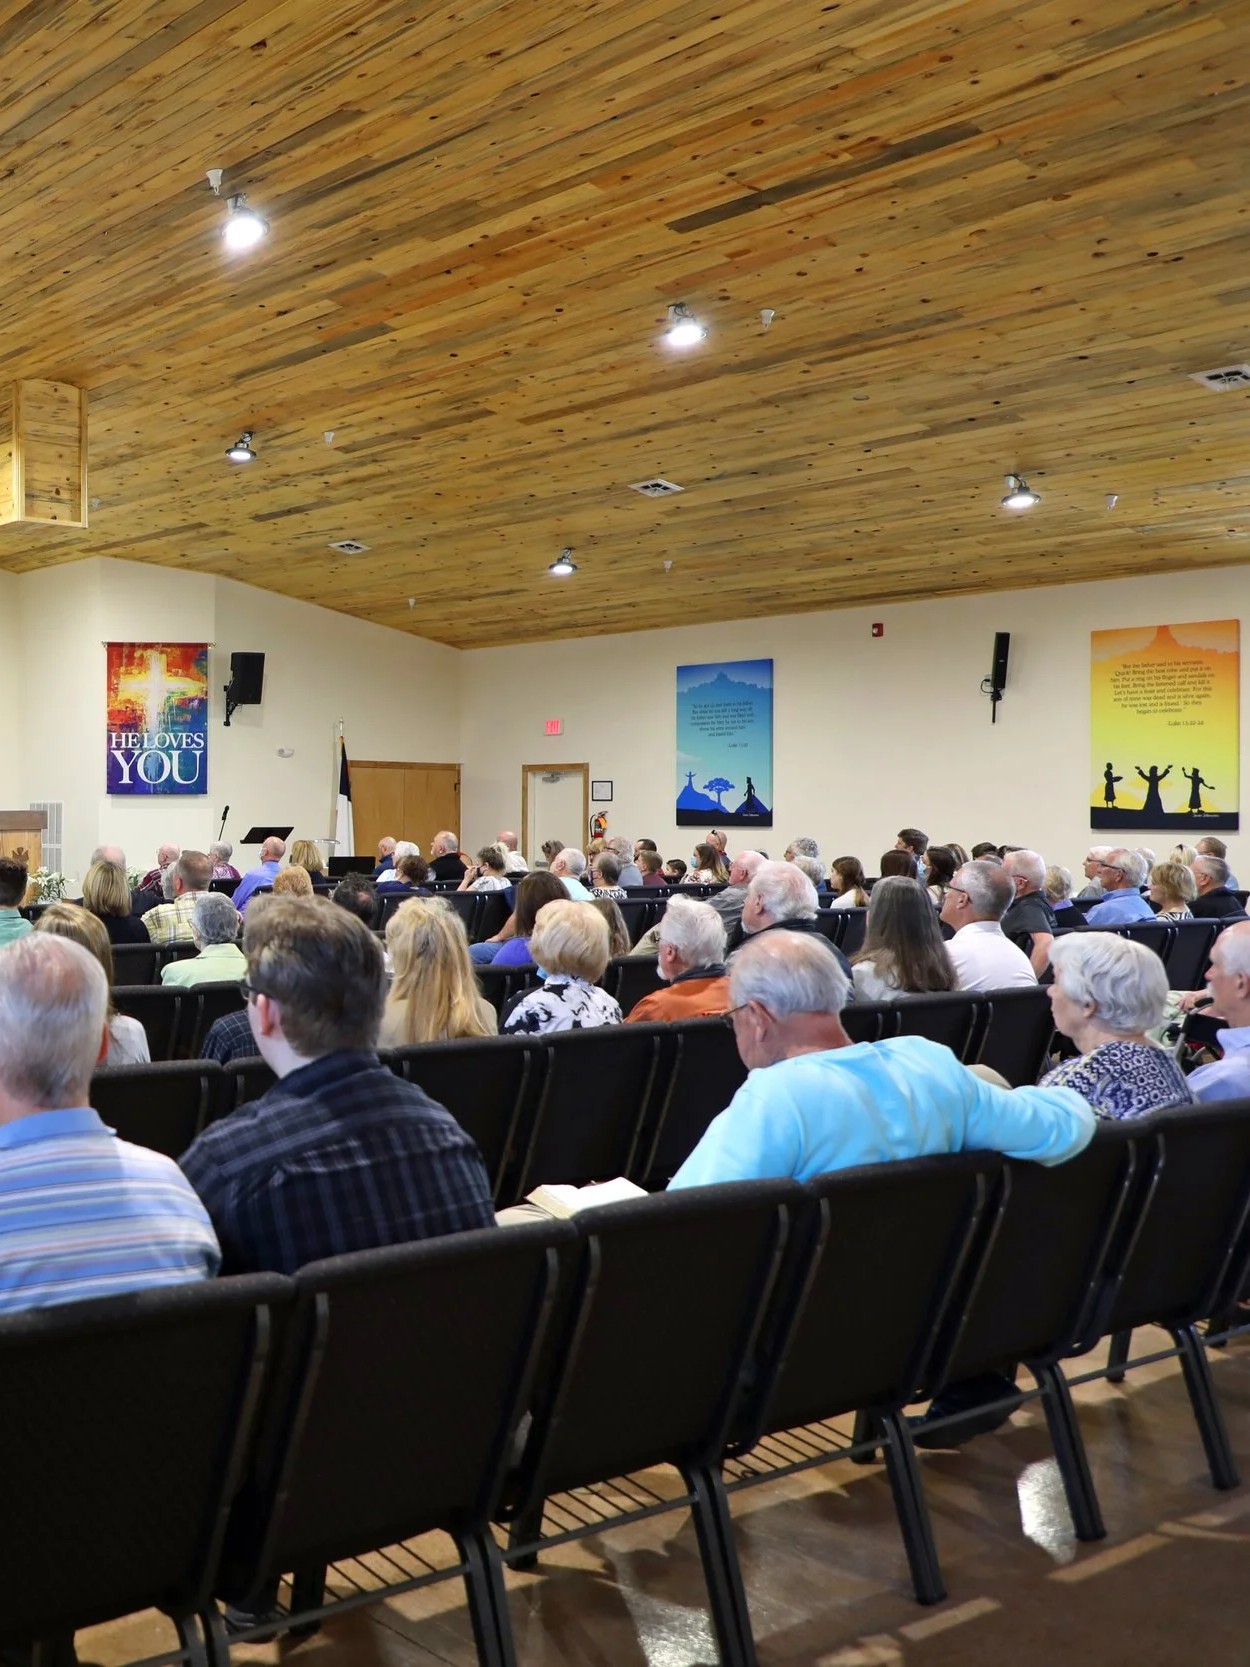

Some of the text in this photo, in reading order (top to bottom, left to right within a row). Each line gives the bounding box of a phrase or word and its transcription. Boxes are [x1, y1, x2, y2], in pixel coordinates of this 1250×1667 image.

[110, 733, 204, 748] HE LOVES
[111, 750, 204, 784] YOU
